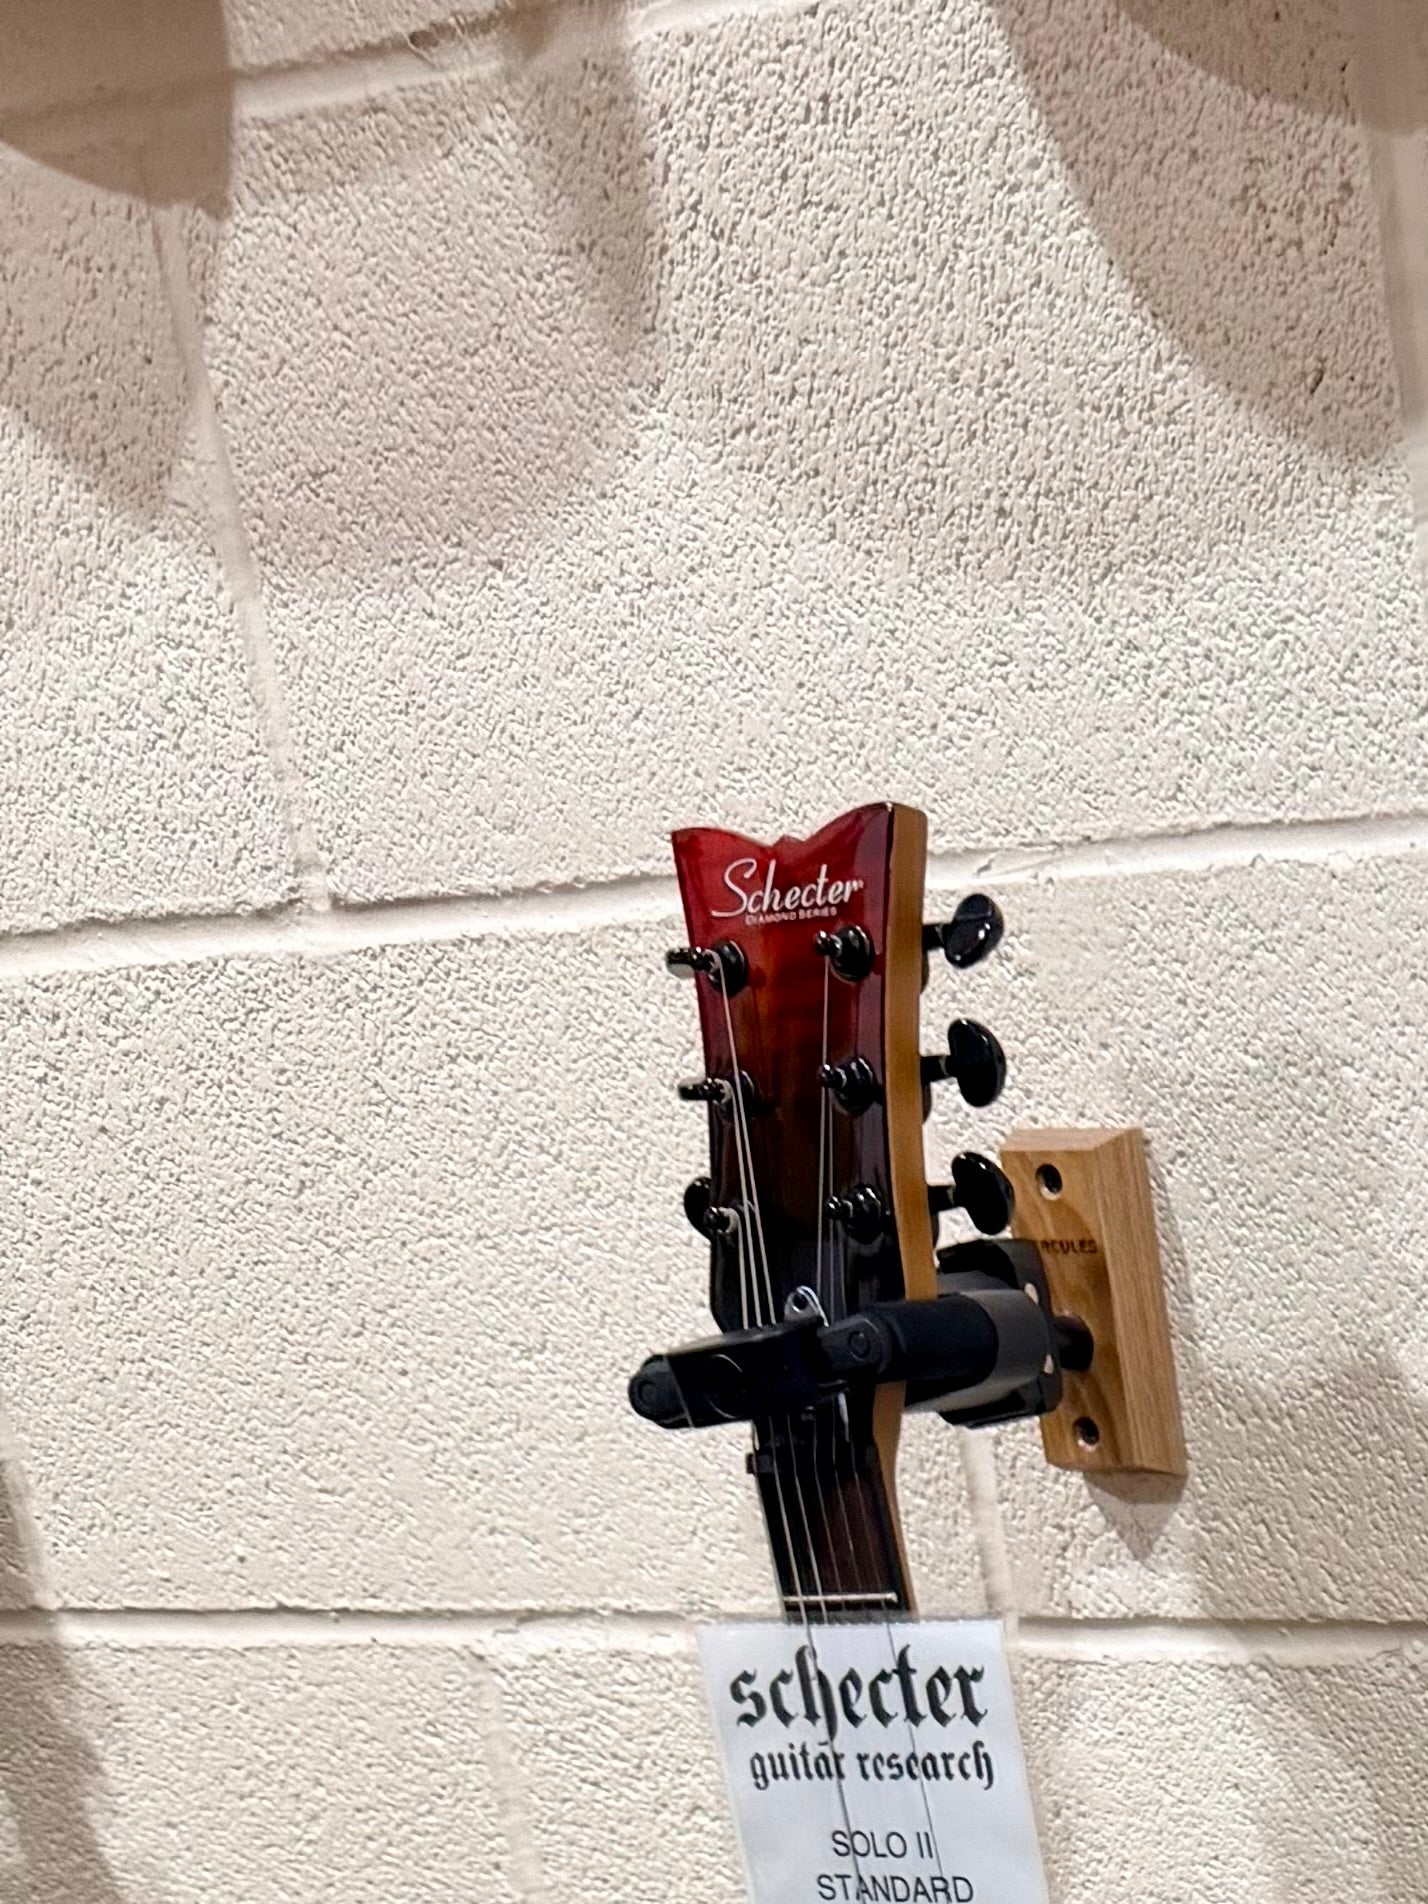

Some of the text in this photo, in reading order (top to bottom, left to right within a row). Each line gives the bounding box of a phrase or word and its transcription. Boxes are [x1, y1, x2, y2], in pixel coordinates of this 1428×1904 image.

[711, 857, 861, 917] Schecter
[745, 906, 838, 925] DIAMOND SERIES
[729, 1642, 988, 1743] schecter
[750, 1740, 994, 1790] guitar research
[832, 1831, 934, 1859] SOLO II
[817, 1874, 974, 1904] STANDARD
